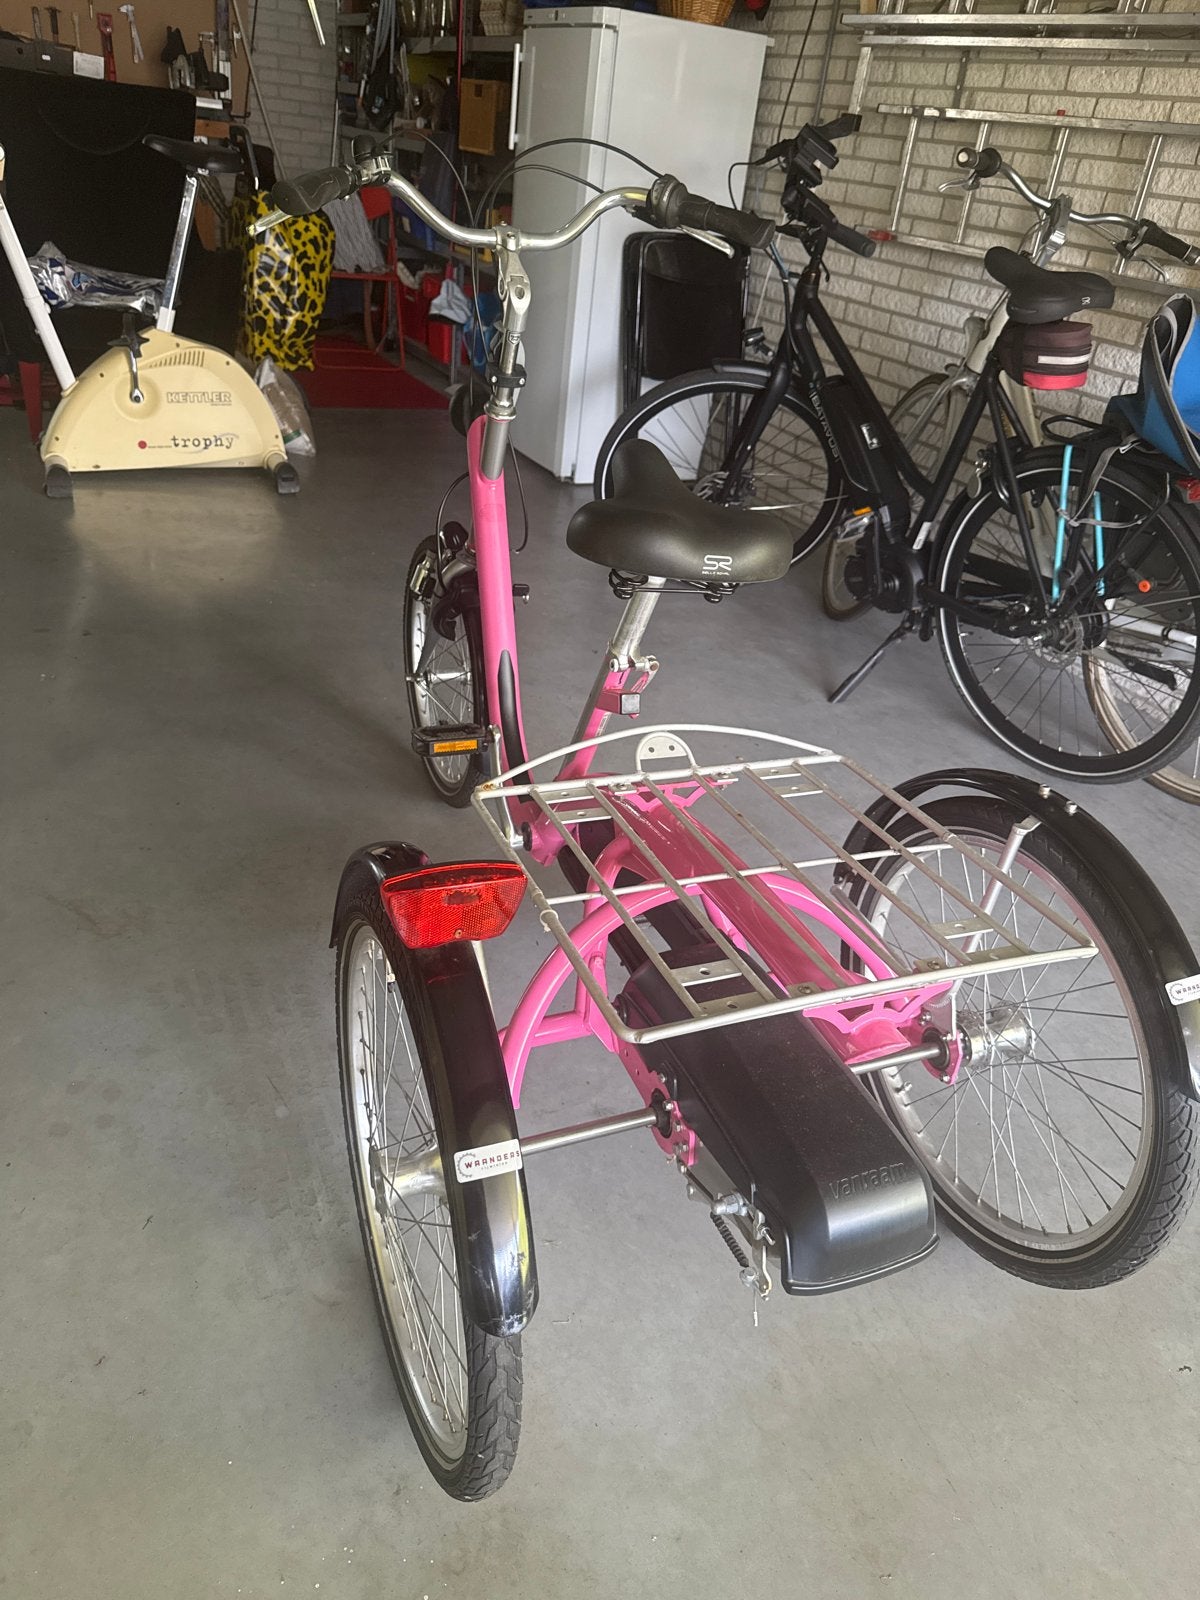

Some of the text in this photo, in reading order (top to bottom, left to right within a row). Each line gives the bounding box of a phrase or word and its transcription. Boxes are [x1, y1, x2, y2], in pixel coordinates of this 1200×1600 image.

[167, 391, 232, 404] KETTLER
[171, 435, 234, 450] trophy
[465, 1150, 520, 1169] WAANDERS
